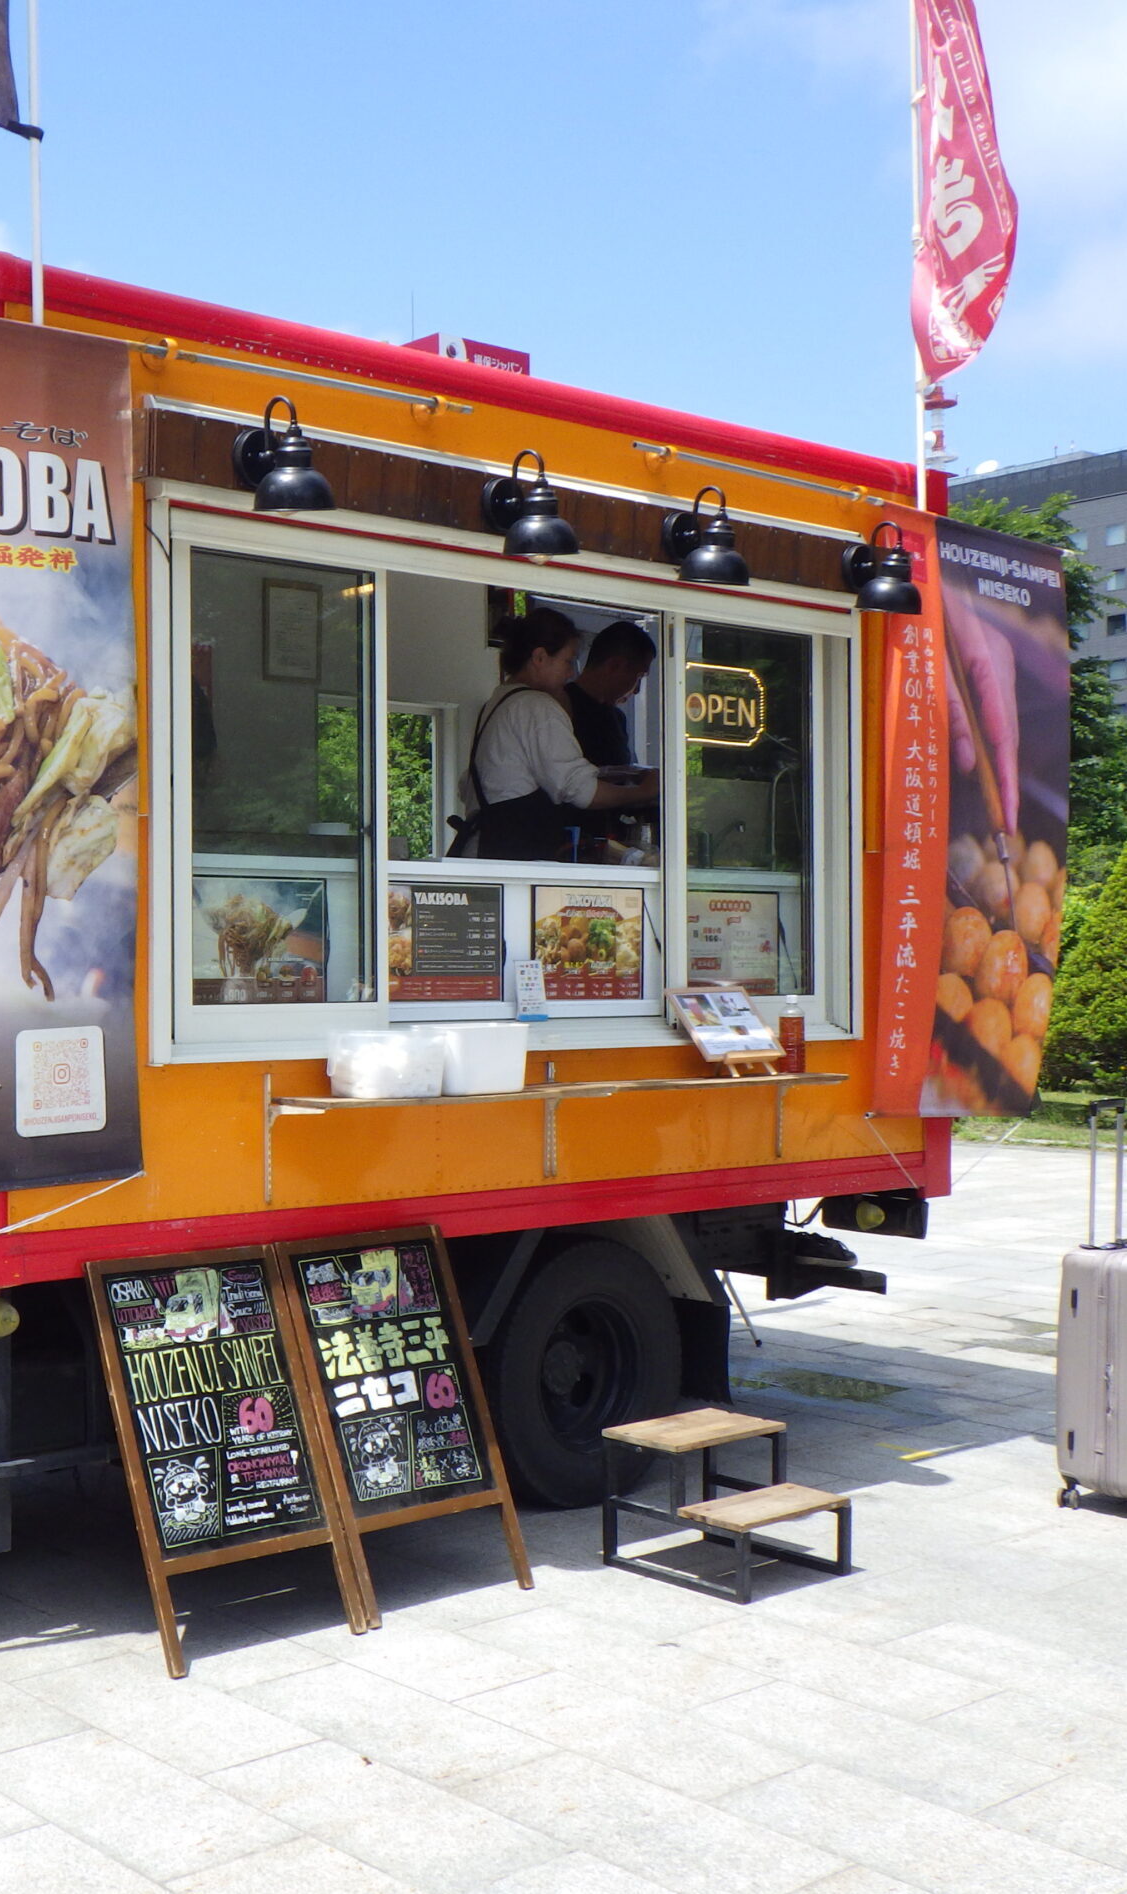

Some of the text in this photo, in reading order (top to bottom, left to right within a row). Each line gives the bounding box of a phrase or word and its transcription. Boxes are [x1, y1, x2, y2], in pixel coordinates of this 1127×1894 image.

[978, 577, 1031, 607] NISEKO
[686, 692, 756, 728] OPEN
[414, 892, 469, 905] YAKISOBA
[111, 1280, 151, 1303] OSAKA
[318, 1316, 450, 1380] 法善寺三平
[333, 1370, 420, 1419] ニセコ
[426, 1372, 456, 1410] 60
[137, 1397, 222, 1454] NISEKO
[239, 1397, 274, 1434] 60
[232, 1434, 255, 1446] YEARS
